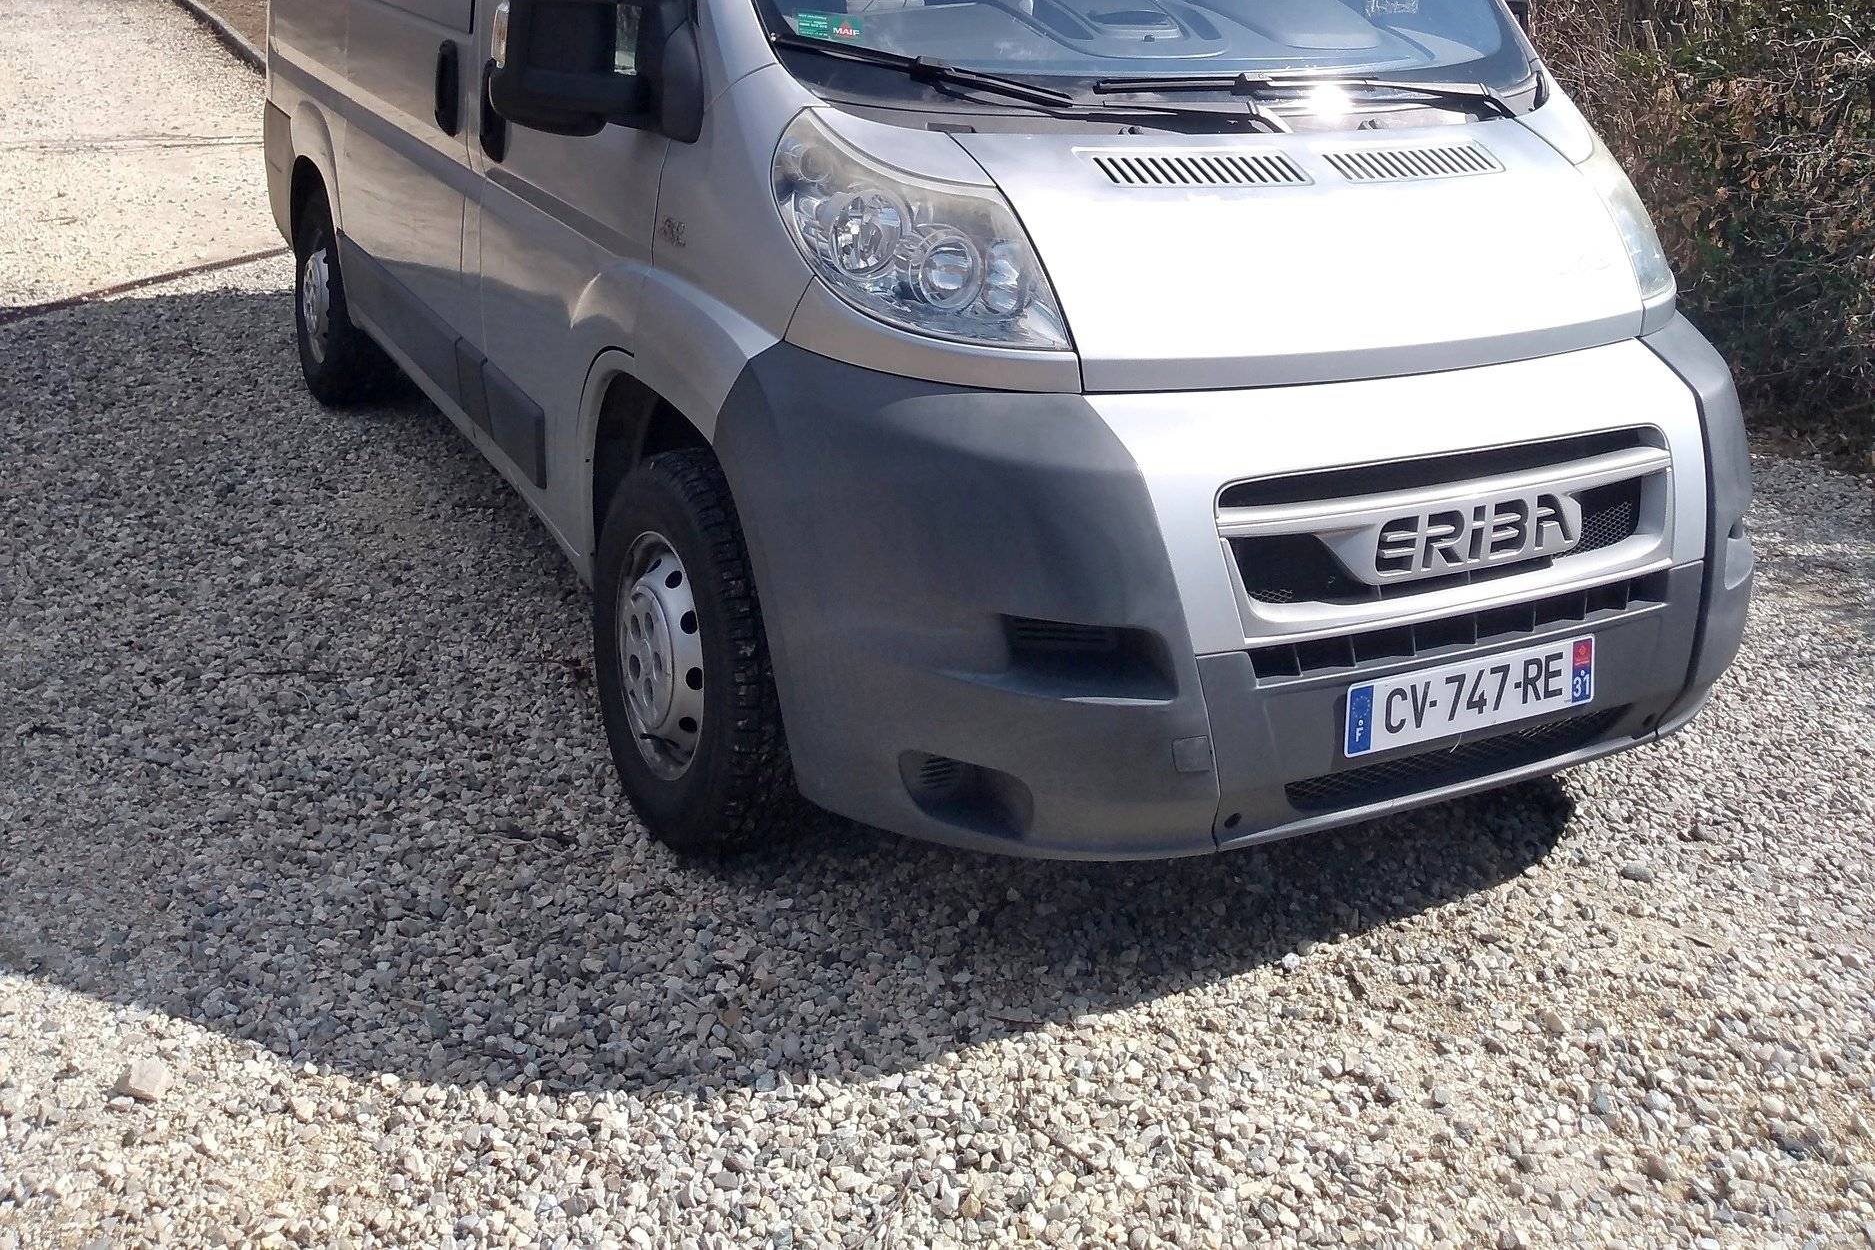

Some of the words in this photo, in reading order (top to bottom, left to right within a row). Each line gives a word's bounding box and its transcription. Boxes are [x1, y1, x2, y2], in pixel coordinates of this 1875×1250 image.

[832, 27, 860, 36] MAIF
[1375, 493, 1573, 577] ERIBA
[1384, 651, 1564, 734] CV-747-RE
[1573, 673, 1590, 697] 31
[1355, 727, 1364, 742] F
